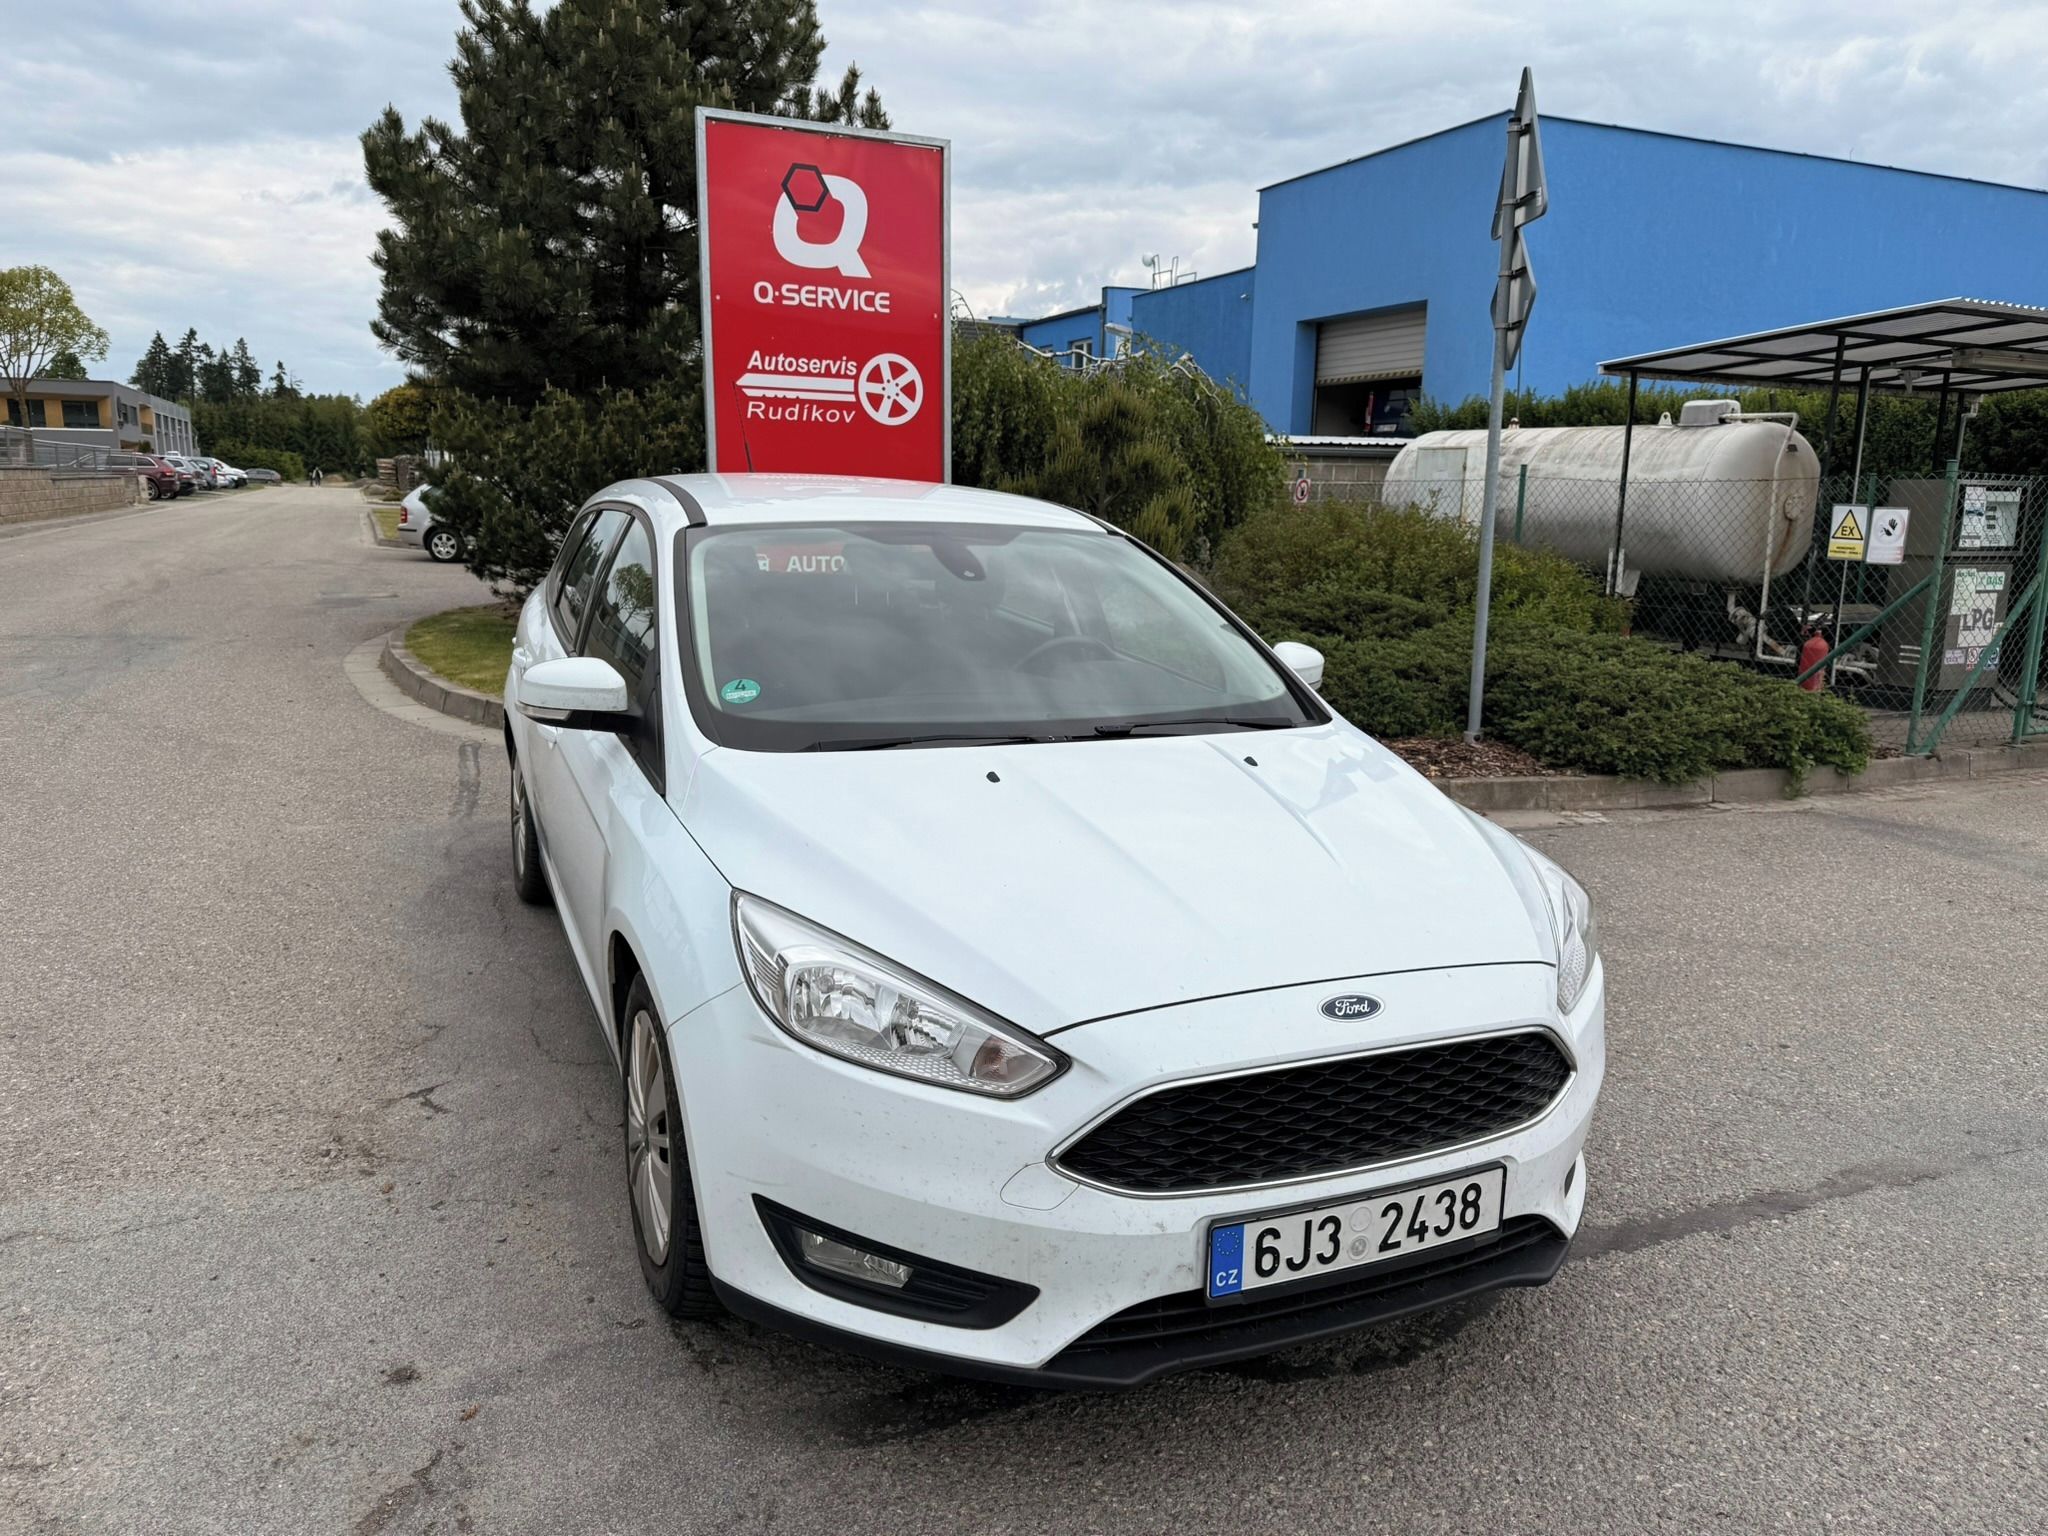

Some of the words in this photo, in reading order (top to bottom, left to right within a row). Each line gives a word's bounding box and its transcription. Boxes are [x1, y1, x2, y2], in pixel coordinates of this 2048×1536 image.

[747, 350, 857, 375] Autoservis
[746, 401, 857, 424] Rudíkov
[1840, 525, 1856, 537] EX
[1961, 607, 1993, 631] LPG
[735, 679, 746, 691] 4
[1335, 998, 1370, 1016] Ford
[1255, 1215, 1342, 1278] 6J3
[1378, 1183, 1482, 1253] 2438
[1215, 1269, 1238, 1287] CZ
